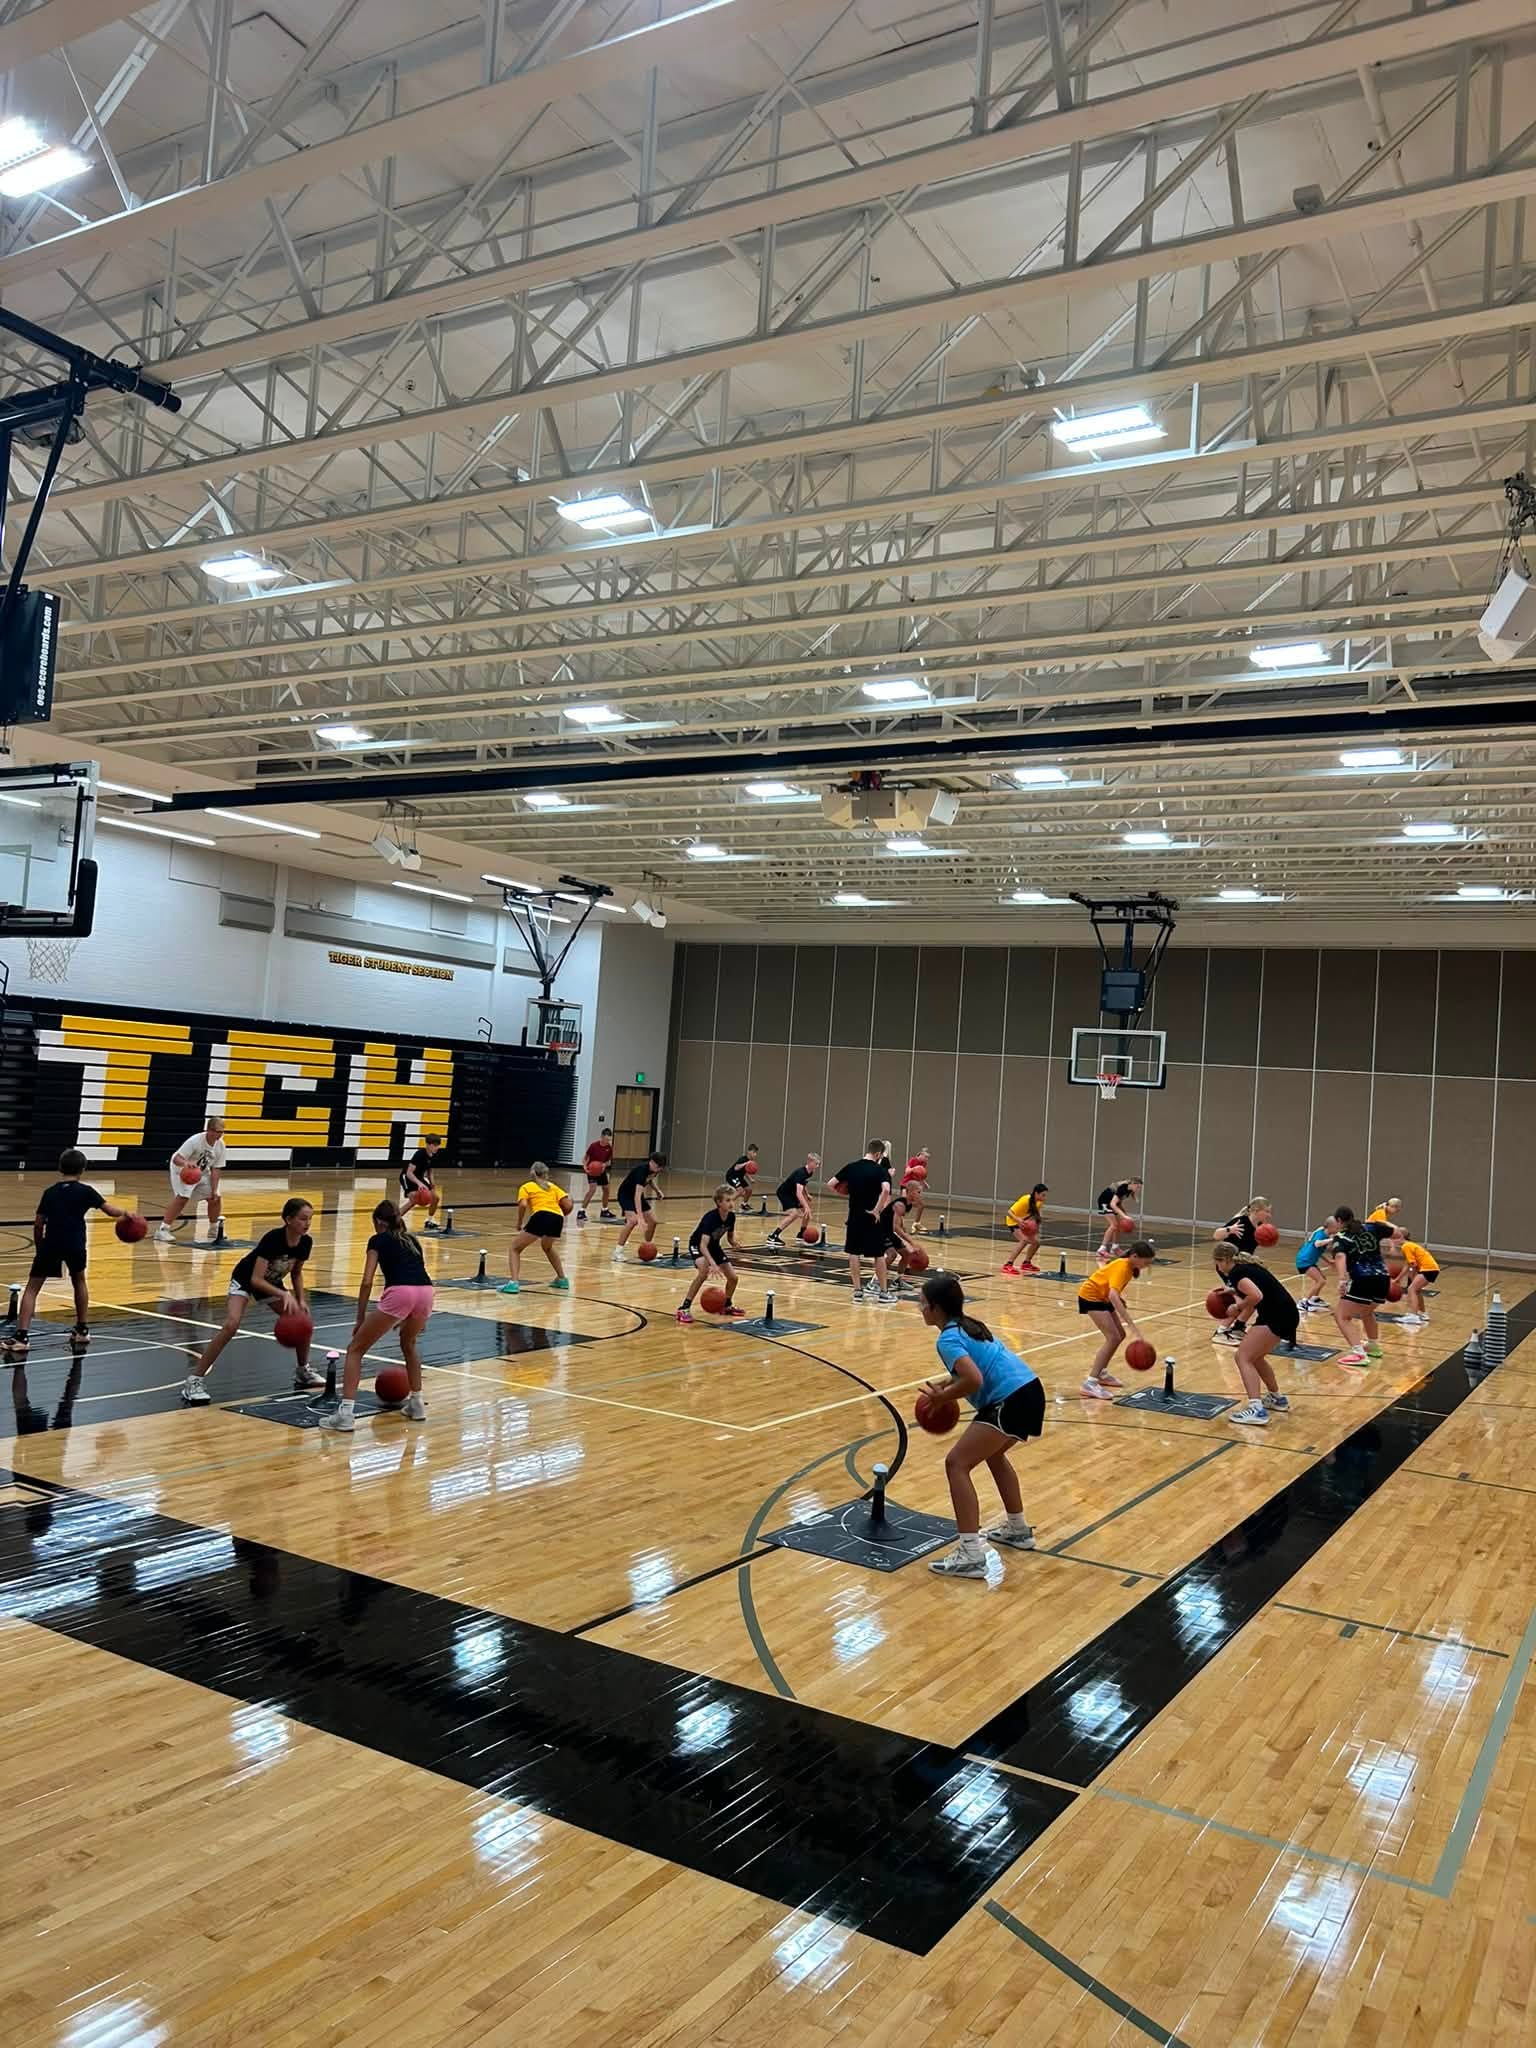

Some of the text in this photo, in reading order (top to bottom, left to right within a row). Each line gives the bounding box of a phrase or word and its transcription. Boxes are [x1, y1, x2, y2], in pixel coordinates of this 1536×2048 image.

[328, 950, 455, 981] TIGER STUDENT SECTION
